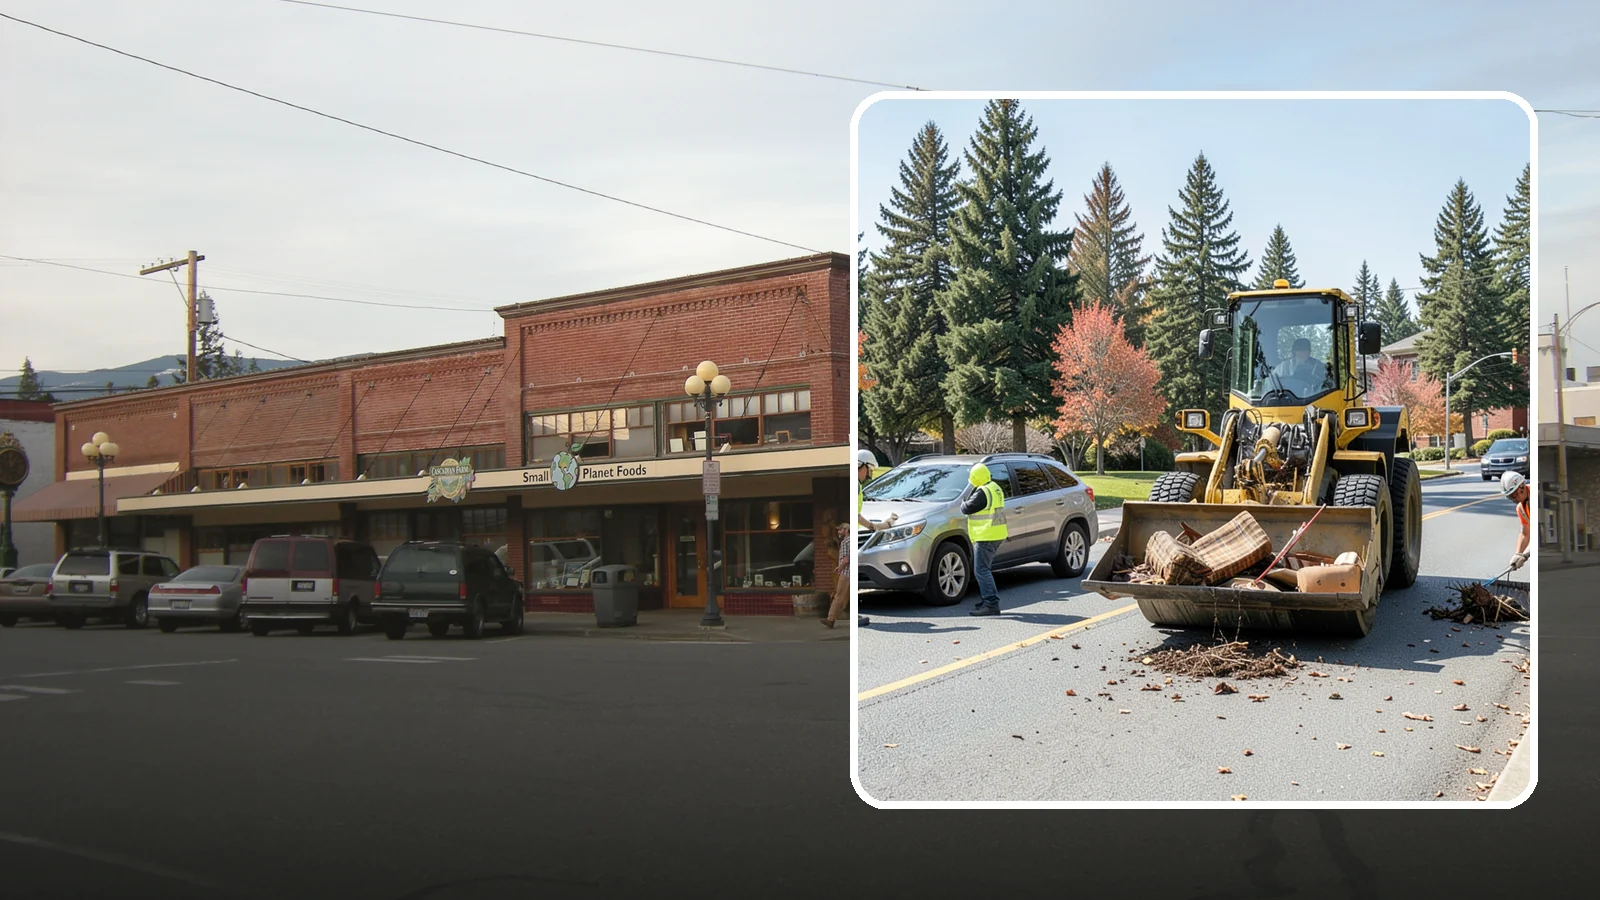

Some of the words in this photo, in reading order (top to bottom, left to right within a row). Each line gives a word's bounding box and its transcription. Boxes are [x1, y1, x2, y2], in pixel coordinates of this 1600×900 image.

[523, 469, 549, 483] Small
[582, 467, 614, 479] Planet
[616, 464, 647, 477] Foods
